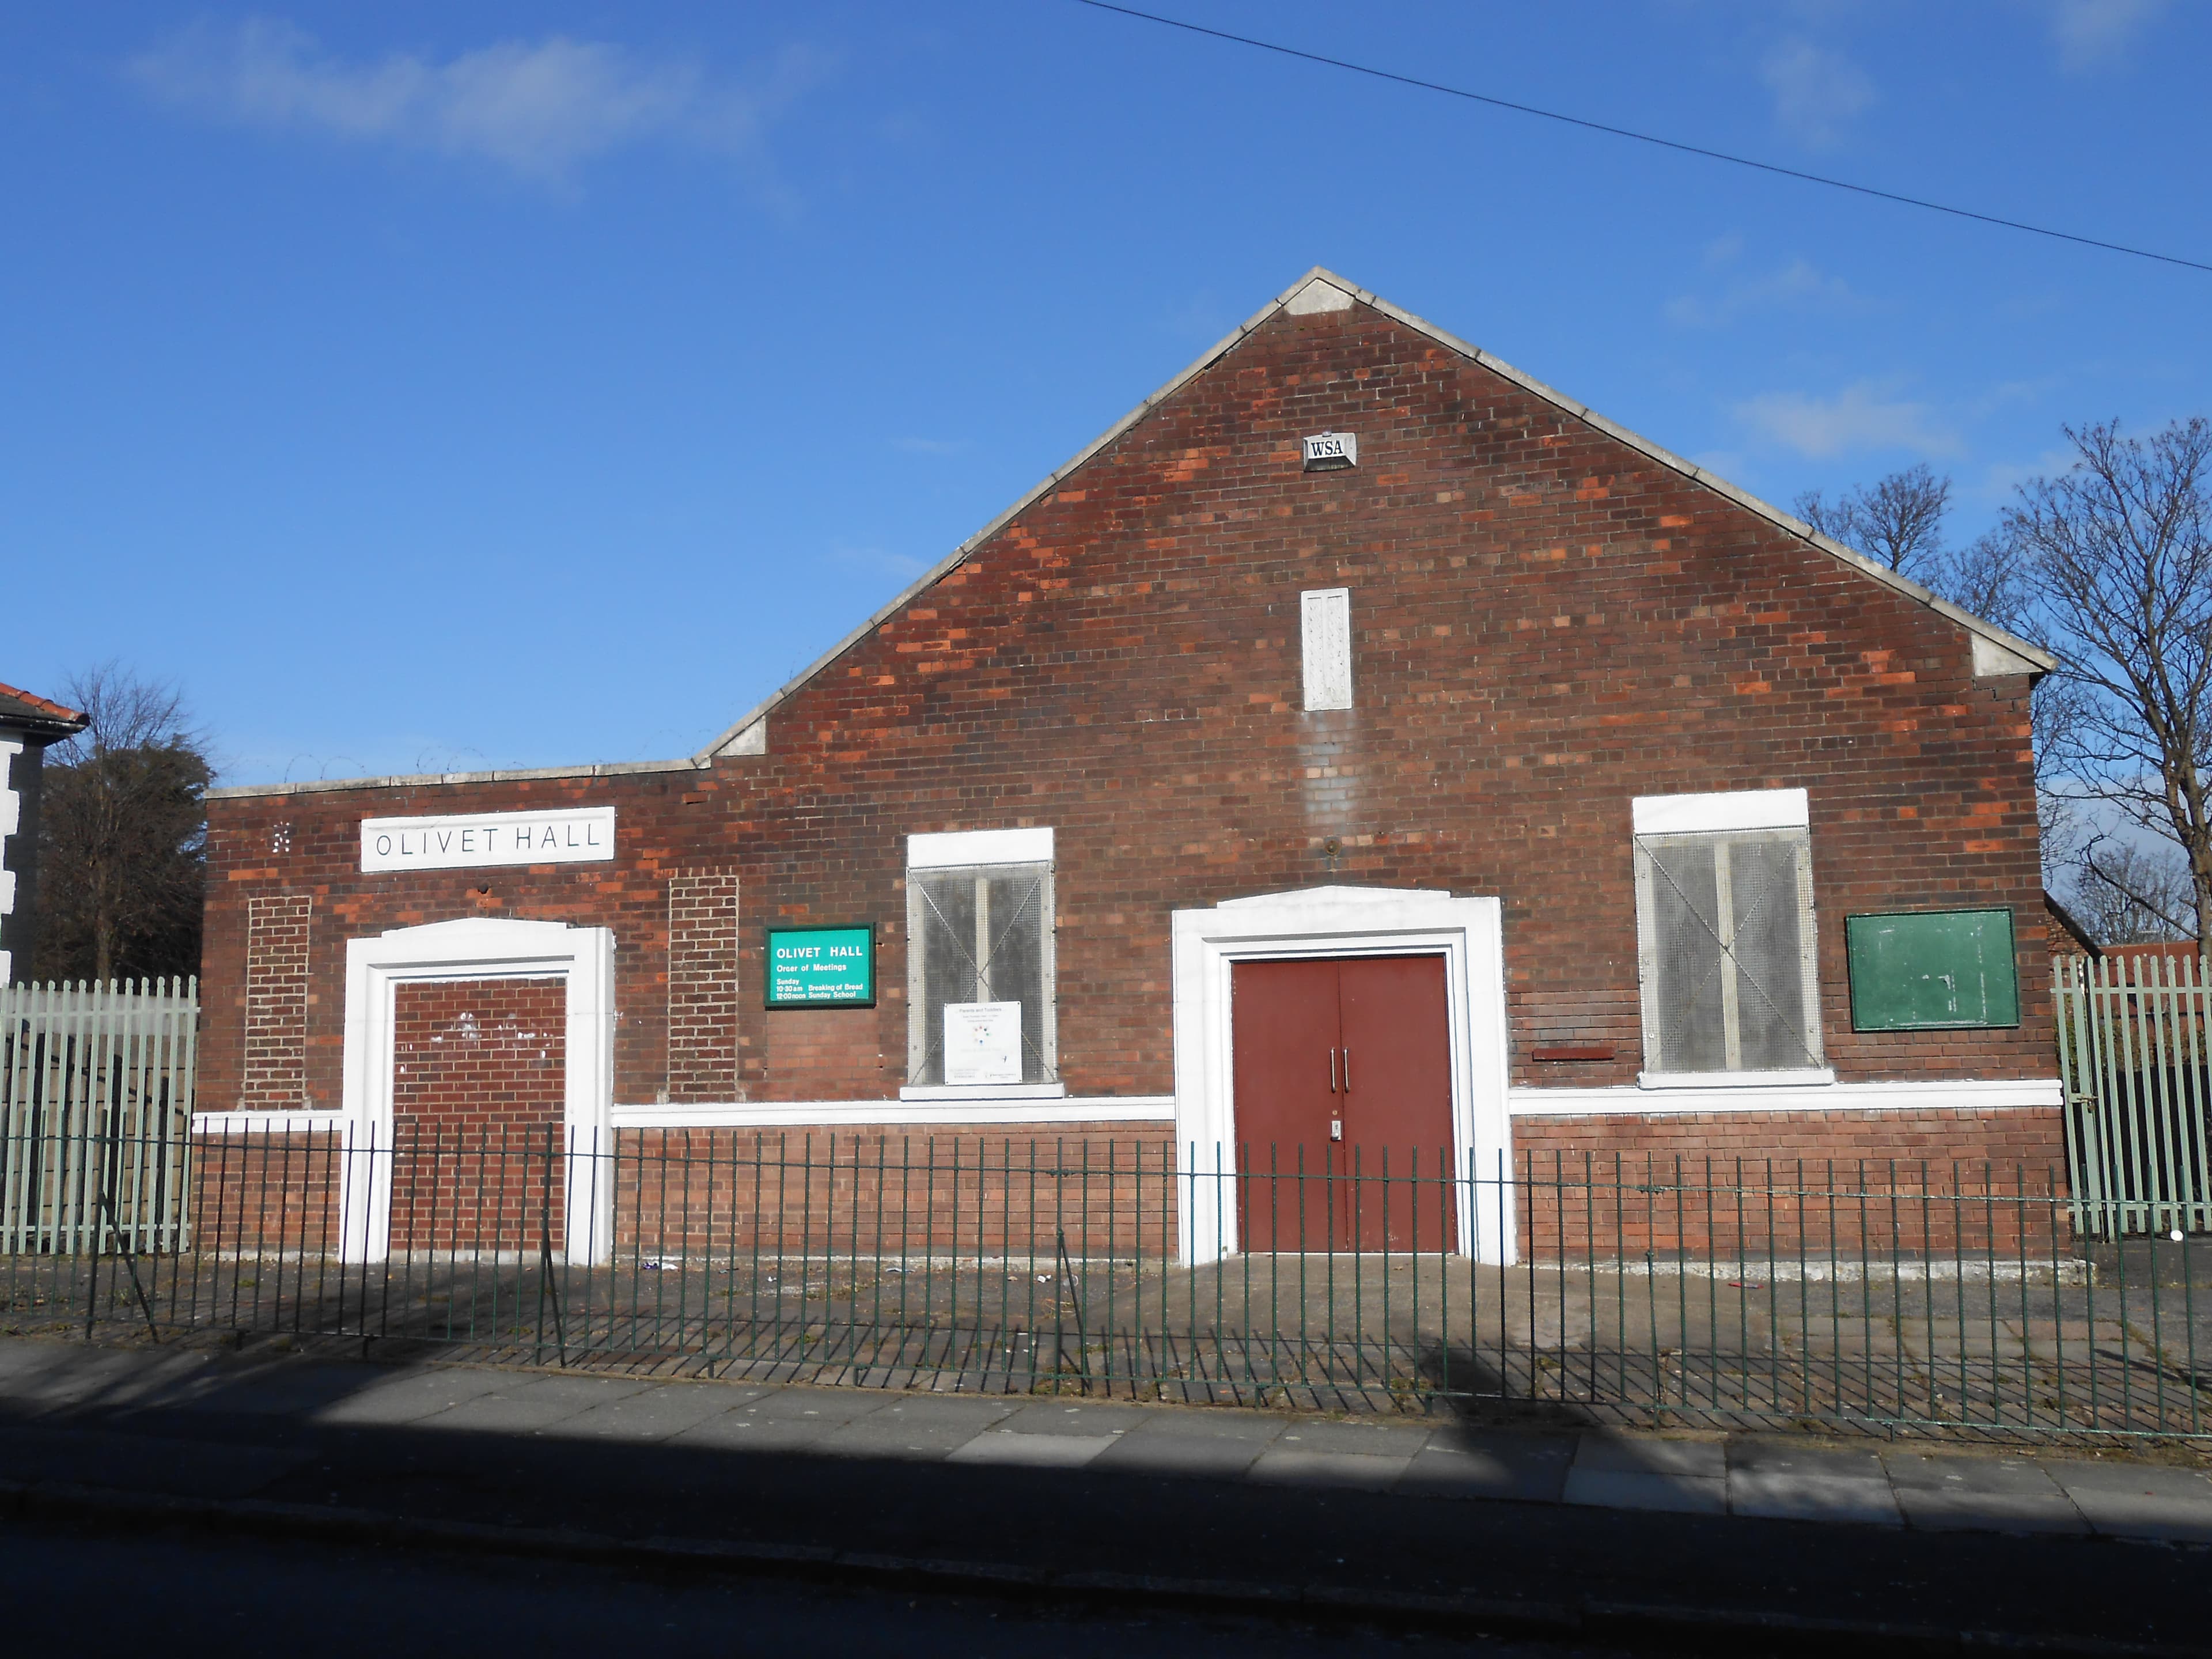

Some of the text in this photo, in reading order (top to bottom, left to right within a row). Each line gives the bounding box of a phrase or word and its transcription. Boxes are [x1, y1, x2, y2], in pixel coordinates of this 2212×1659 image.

[1311, 440, 1343, 456] WSA
[376, 823, 600, 856] OLIVET HALL
[777, 946, 863, 959] OLIVET HALL
[813, 963, 847, 971] Meetings
